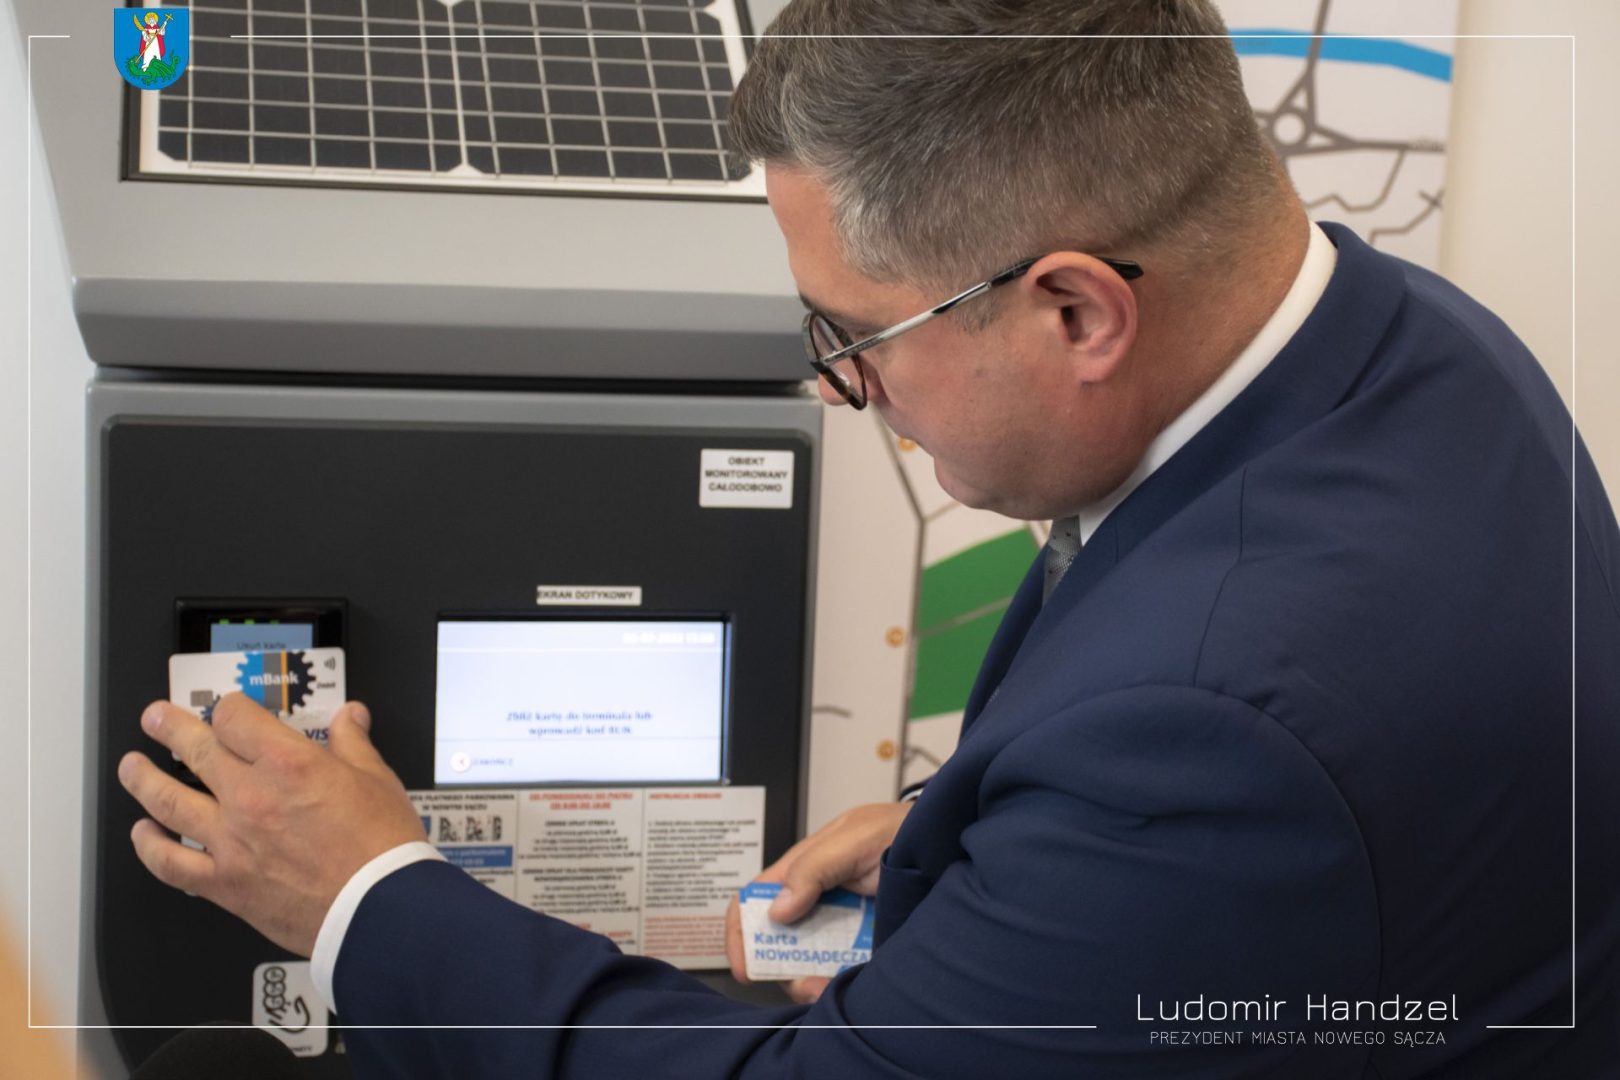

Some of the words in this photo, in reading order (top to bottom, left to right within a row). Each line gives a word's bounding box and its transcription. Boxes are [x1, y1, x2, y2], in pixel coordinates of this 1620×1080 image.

[727, 456, 766, 466] OBIEKT
[704, 469, 788, 479] MONITOROWANY
[537, 590, 573, 599] EKRAN
[574, 590, 634, 600] DOTYKOWY
[249, 670, 299, 687] mBank
[304, 728, 330, 742] VIS
[754, 932, 798, 946] Karta
[754, 949, 870, 965] NOWOSĄDECZA
